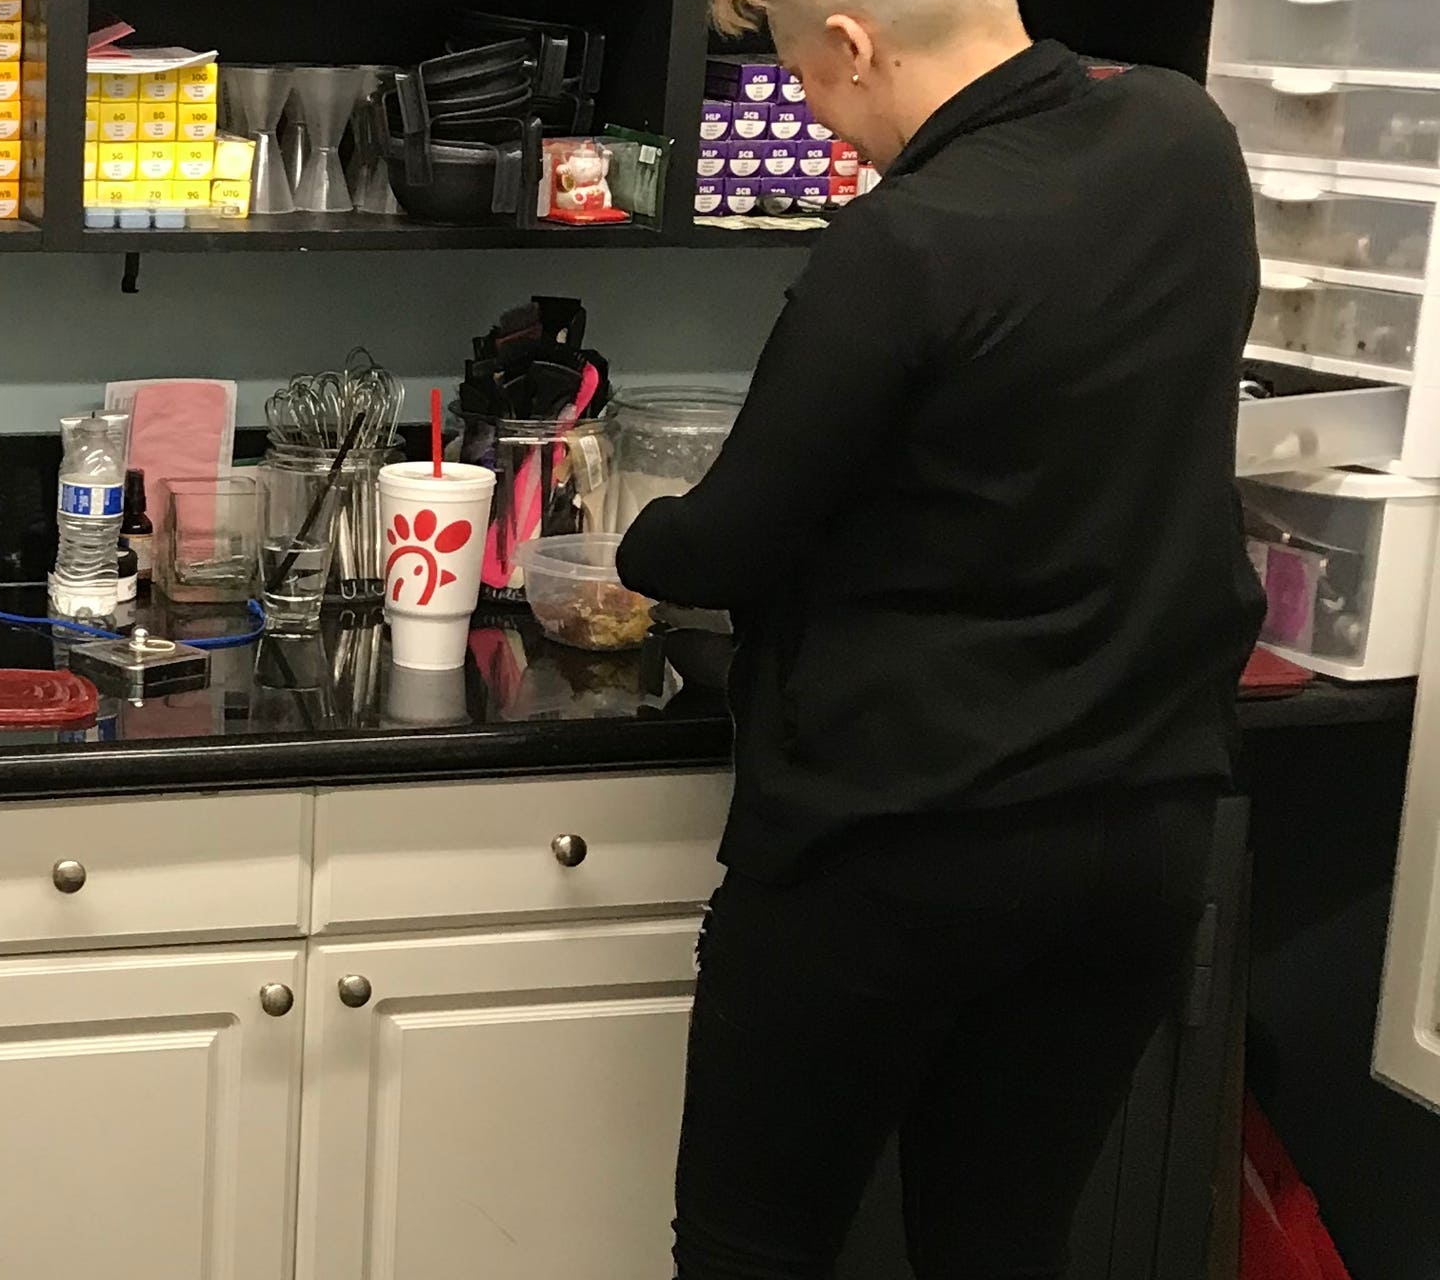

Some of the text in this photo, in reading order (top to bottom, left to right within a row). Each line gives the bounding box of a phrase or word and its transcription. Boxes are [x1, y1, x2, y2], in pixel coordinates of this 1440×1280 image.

[192, 73, 208, 82] 10G
[753, 75, 768, 83] 6CB
[192, 112, 208, 121] 10G
[705, 113, 720, 121] HLP
[744, 111, 758, 120] 5CB
[779, 113, 794, 121] 7CB
[152, 151, 163, 159] 7G
